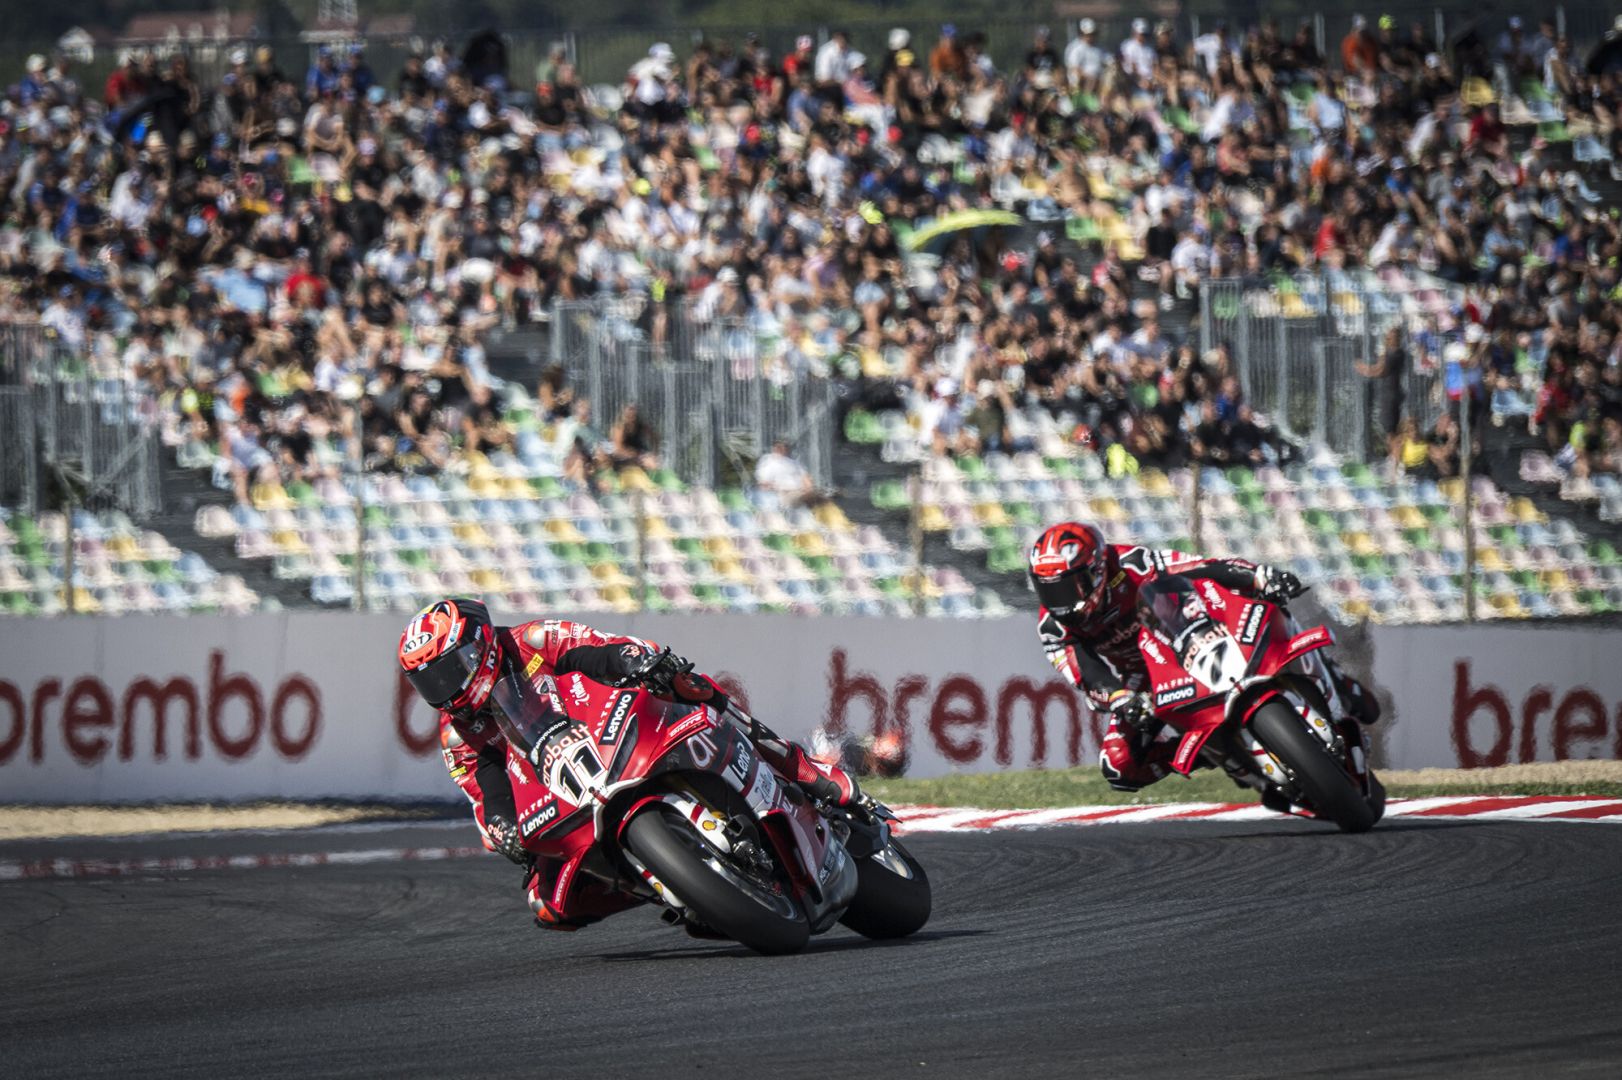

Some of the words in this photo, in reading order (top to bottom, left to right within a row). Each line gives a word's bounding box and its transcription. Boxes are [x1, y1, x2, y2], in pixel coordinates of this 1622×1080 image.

[1242, 605, 1264, 643] Lenovo
[1198, 639, 1229, 686] 7
[594, 690, 620, 738] ALTEN
[603, 694, 632, 741] Lenovo
[823, 646, 1103, 767] brem
[1158, 687, 1194, 706] Lenovo
[1451, 656, 1622, 770] bre
[542, 723, 590, 788] aruba.it
[559, 740, 604, 801] 11
[518, 794, 553, 821] ALTEN
[521, 806, 556, 837] Lenovo
